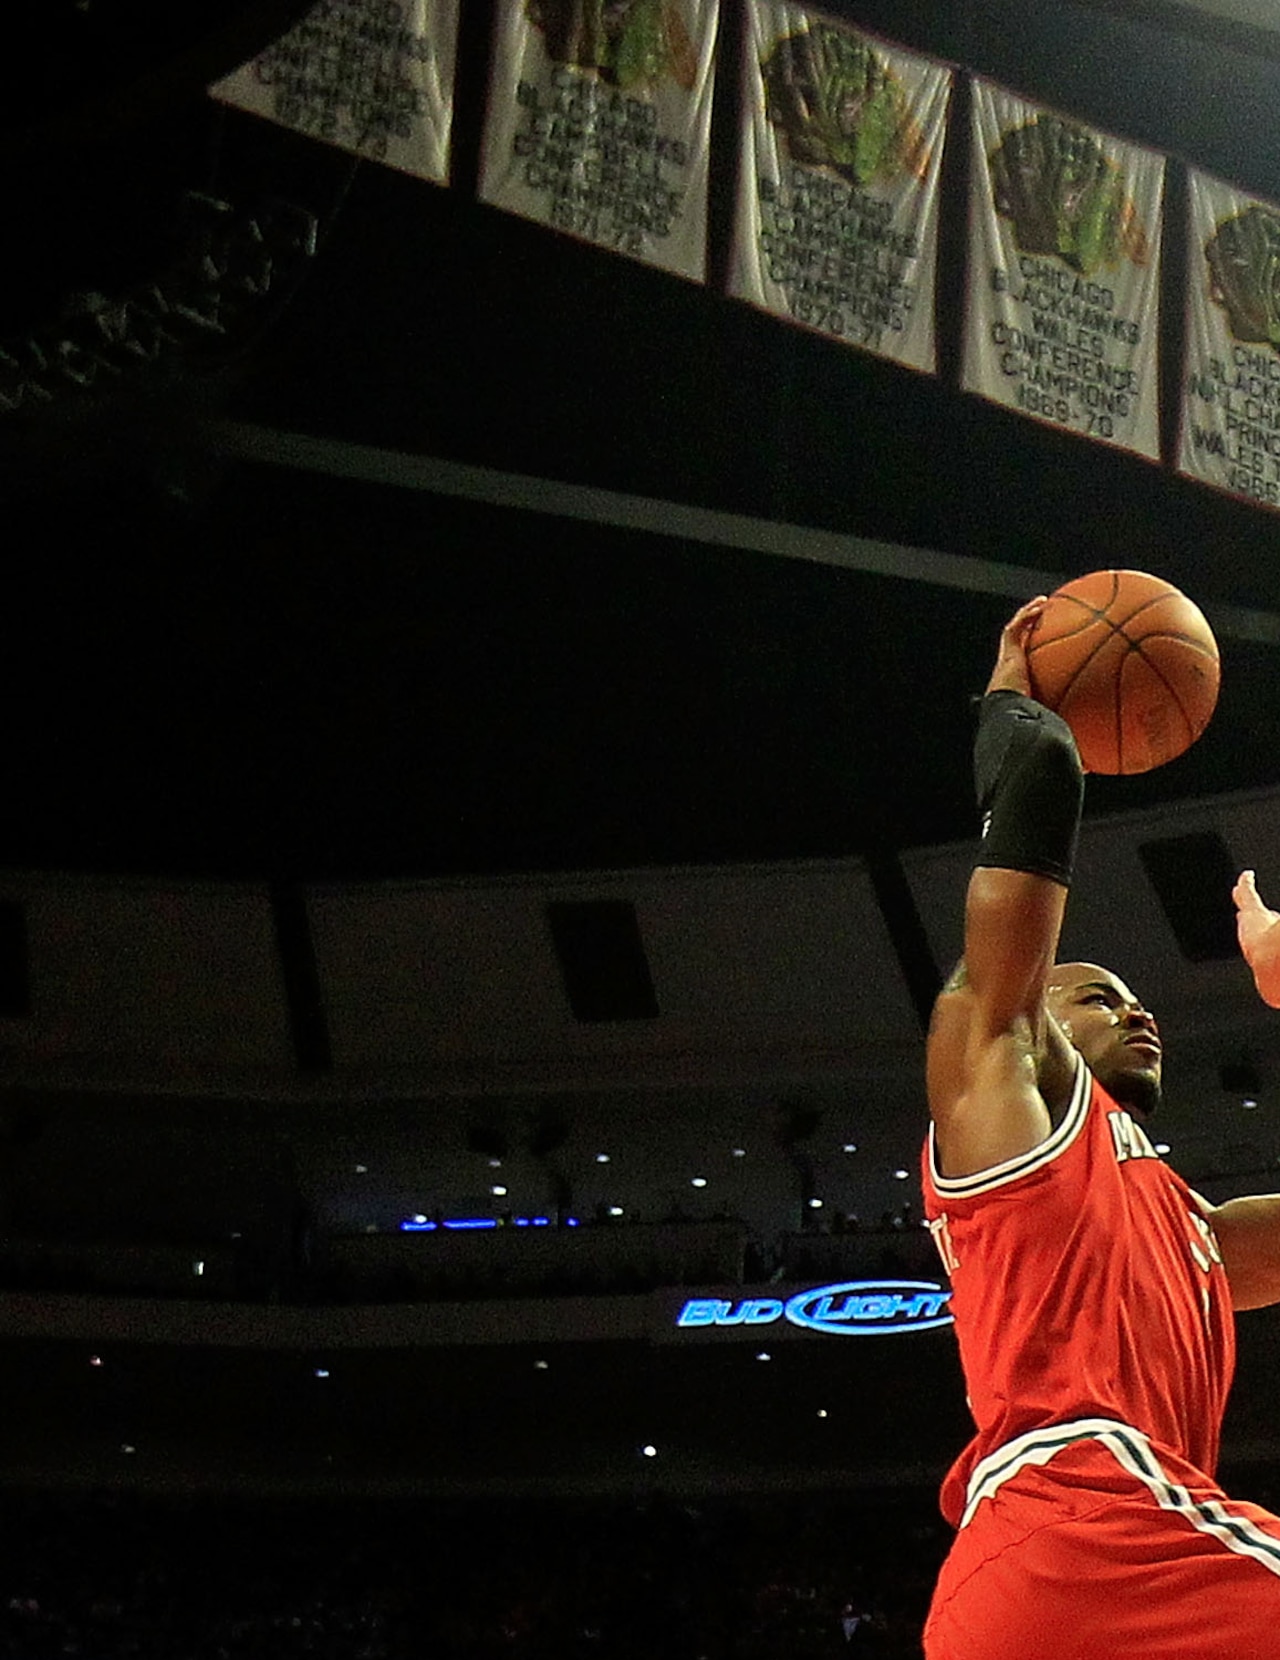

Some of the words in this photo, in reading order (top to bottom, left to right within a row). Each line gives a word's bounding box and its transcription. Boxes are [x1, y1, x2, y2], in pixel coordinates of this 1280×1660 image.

[1020, 255, 1114, 311] CHICAGO
[992, 320, 1139, 395] CONFERENCE
[1031, 309, 1104, 360] WALES
[1001, 351, 1130, 418] CHAMPIONS
[1193, 424, 1264, 474] WALES
[677, 1299, 782, 1327] BUD
[809, 1292, 953, 1322] LIGHT
